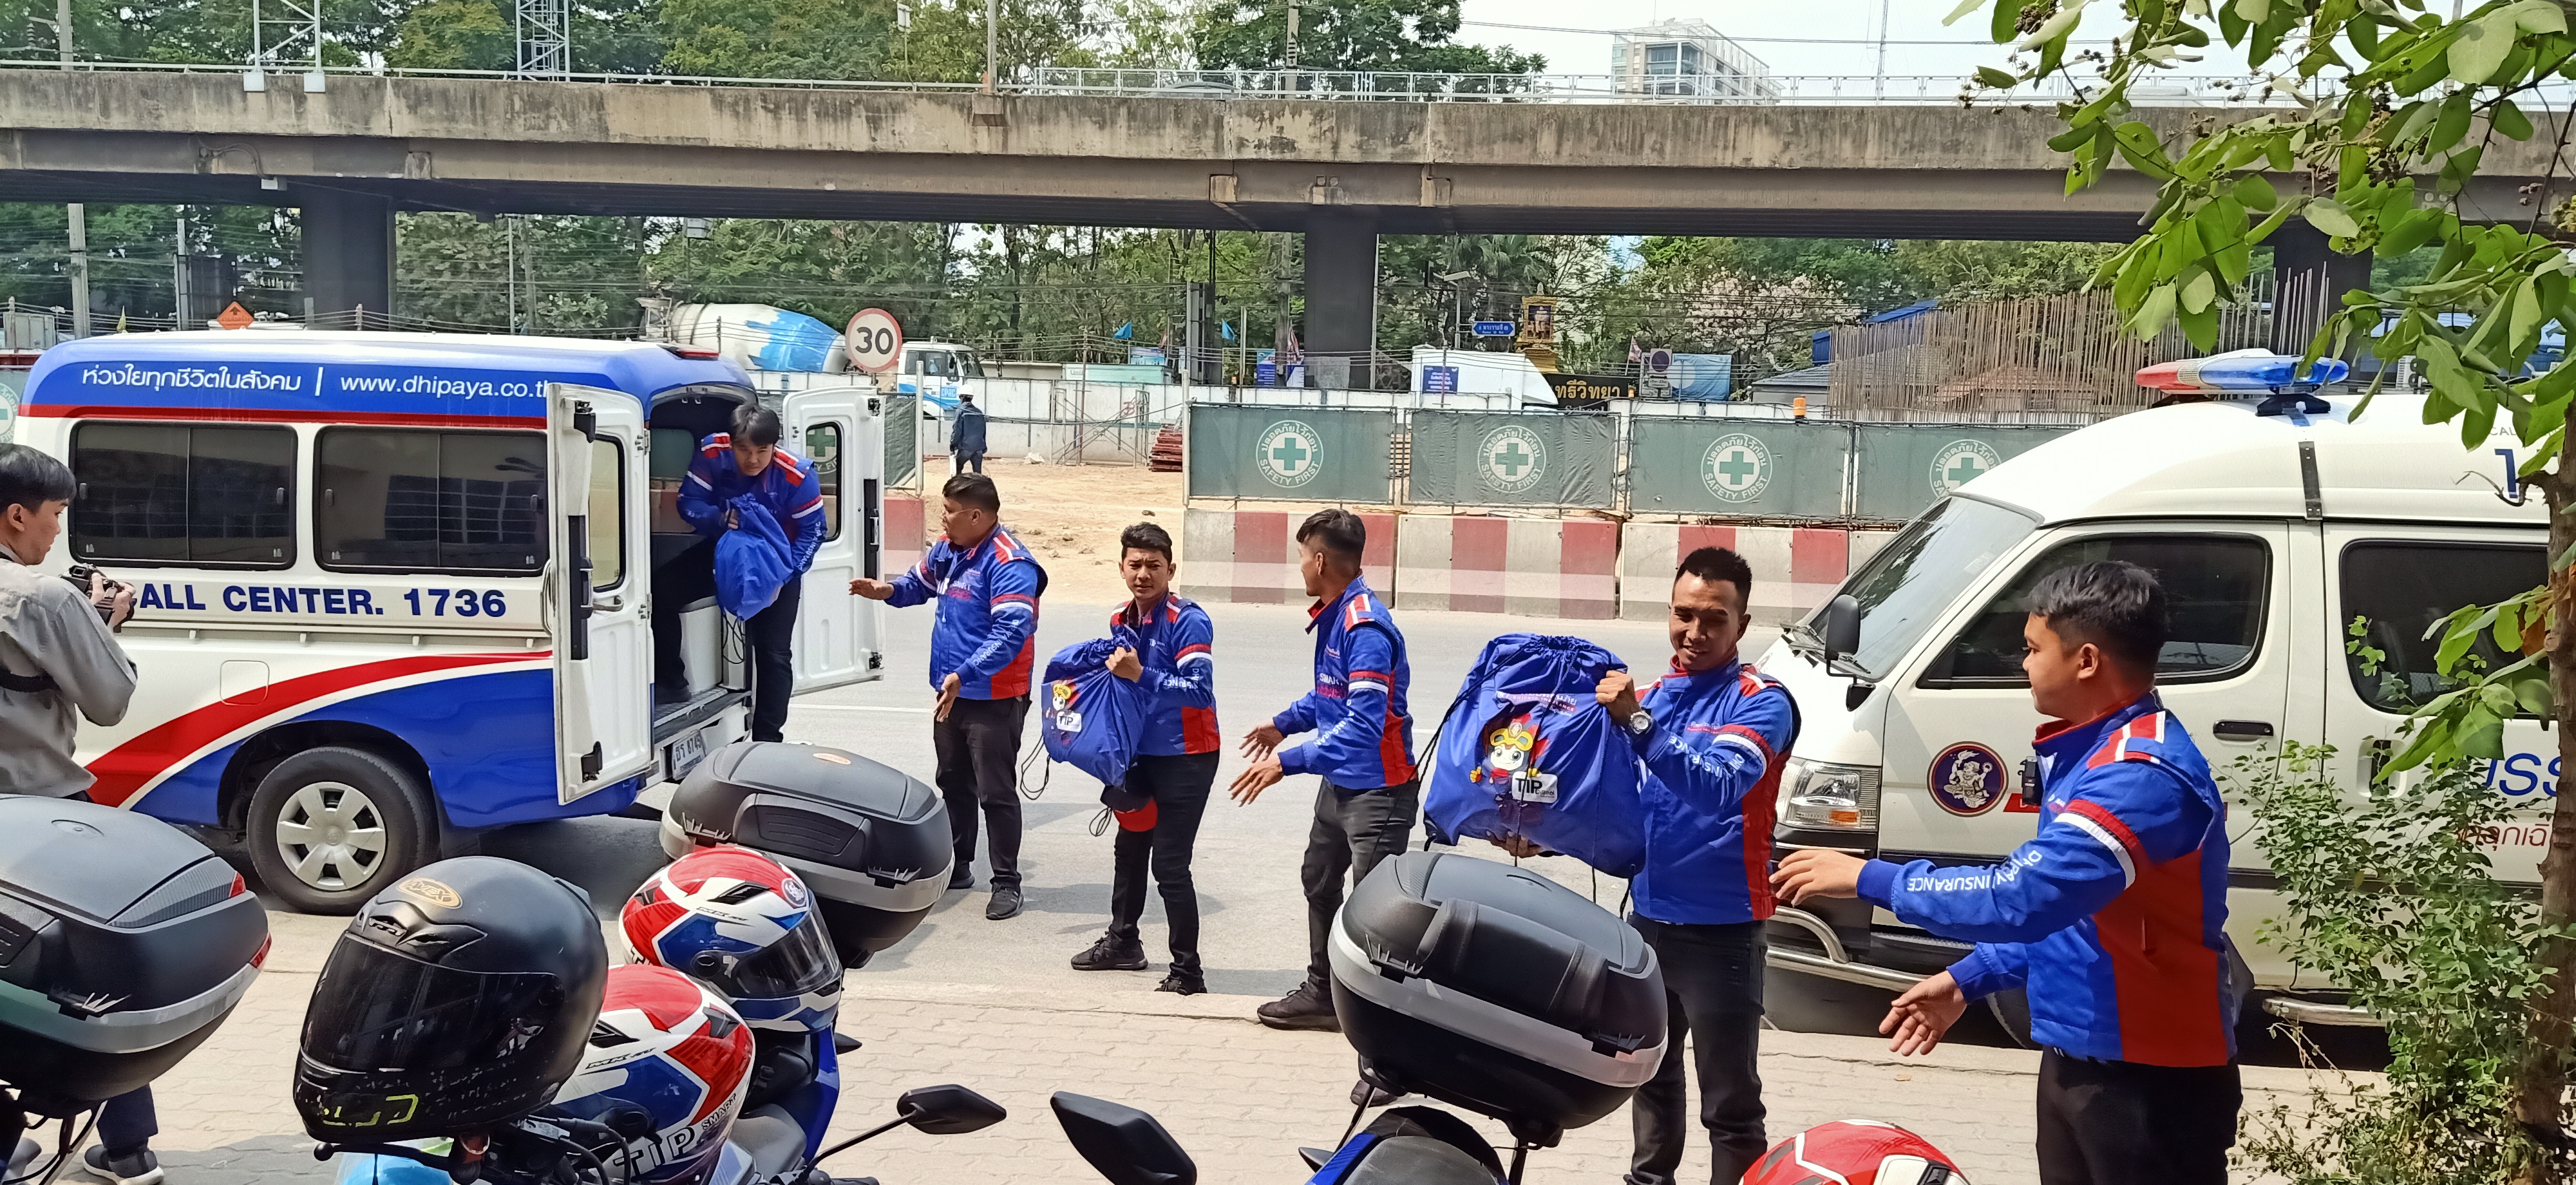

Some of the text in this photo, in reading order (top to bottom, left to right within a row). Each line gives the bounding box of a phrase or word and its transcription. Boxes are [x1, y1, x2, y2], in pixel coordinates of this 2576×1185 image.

[855, 327, 893, 355] 30
[82, 363, 301, 392] ห่วงใยทุกชีวิตในสังคม
[942, 388, 956, 397] CPAC
[1261, 422, 1318, 452] ปลอดภัยไว้ก่อน
[1483, 428, 1540, 458] ปลอดภัยไว้ก่อน
[1707, 435, 1767, 467] ปลอดภัยไว้ก่อน
[1260, 459, 1319, 486] SAFETY FIRST
[1481, 464, 1542, 491] SAFETY FIRST
[1705, 473, 1767, 500] SAFETY FIRST
[140, 583, 506, 618] ALL CENTER. 1736
[1059, 716, 1074, 726] TIP
[1515, 778, 1542, 793] TIP
[1907, 875, 1991, 892] INSURANCE
[612, 1093, 737, 1176] TIP SMART
